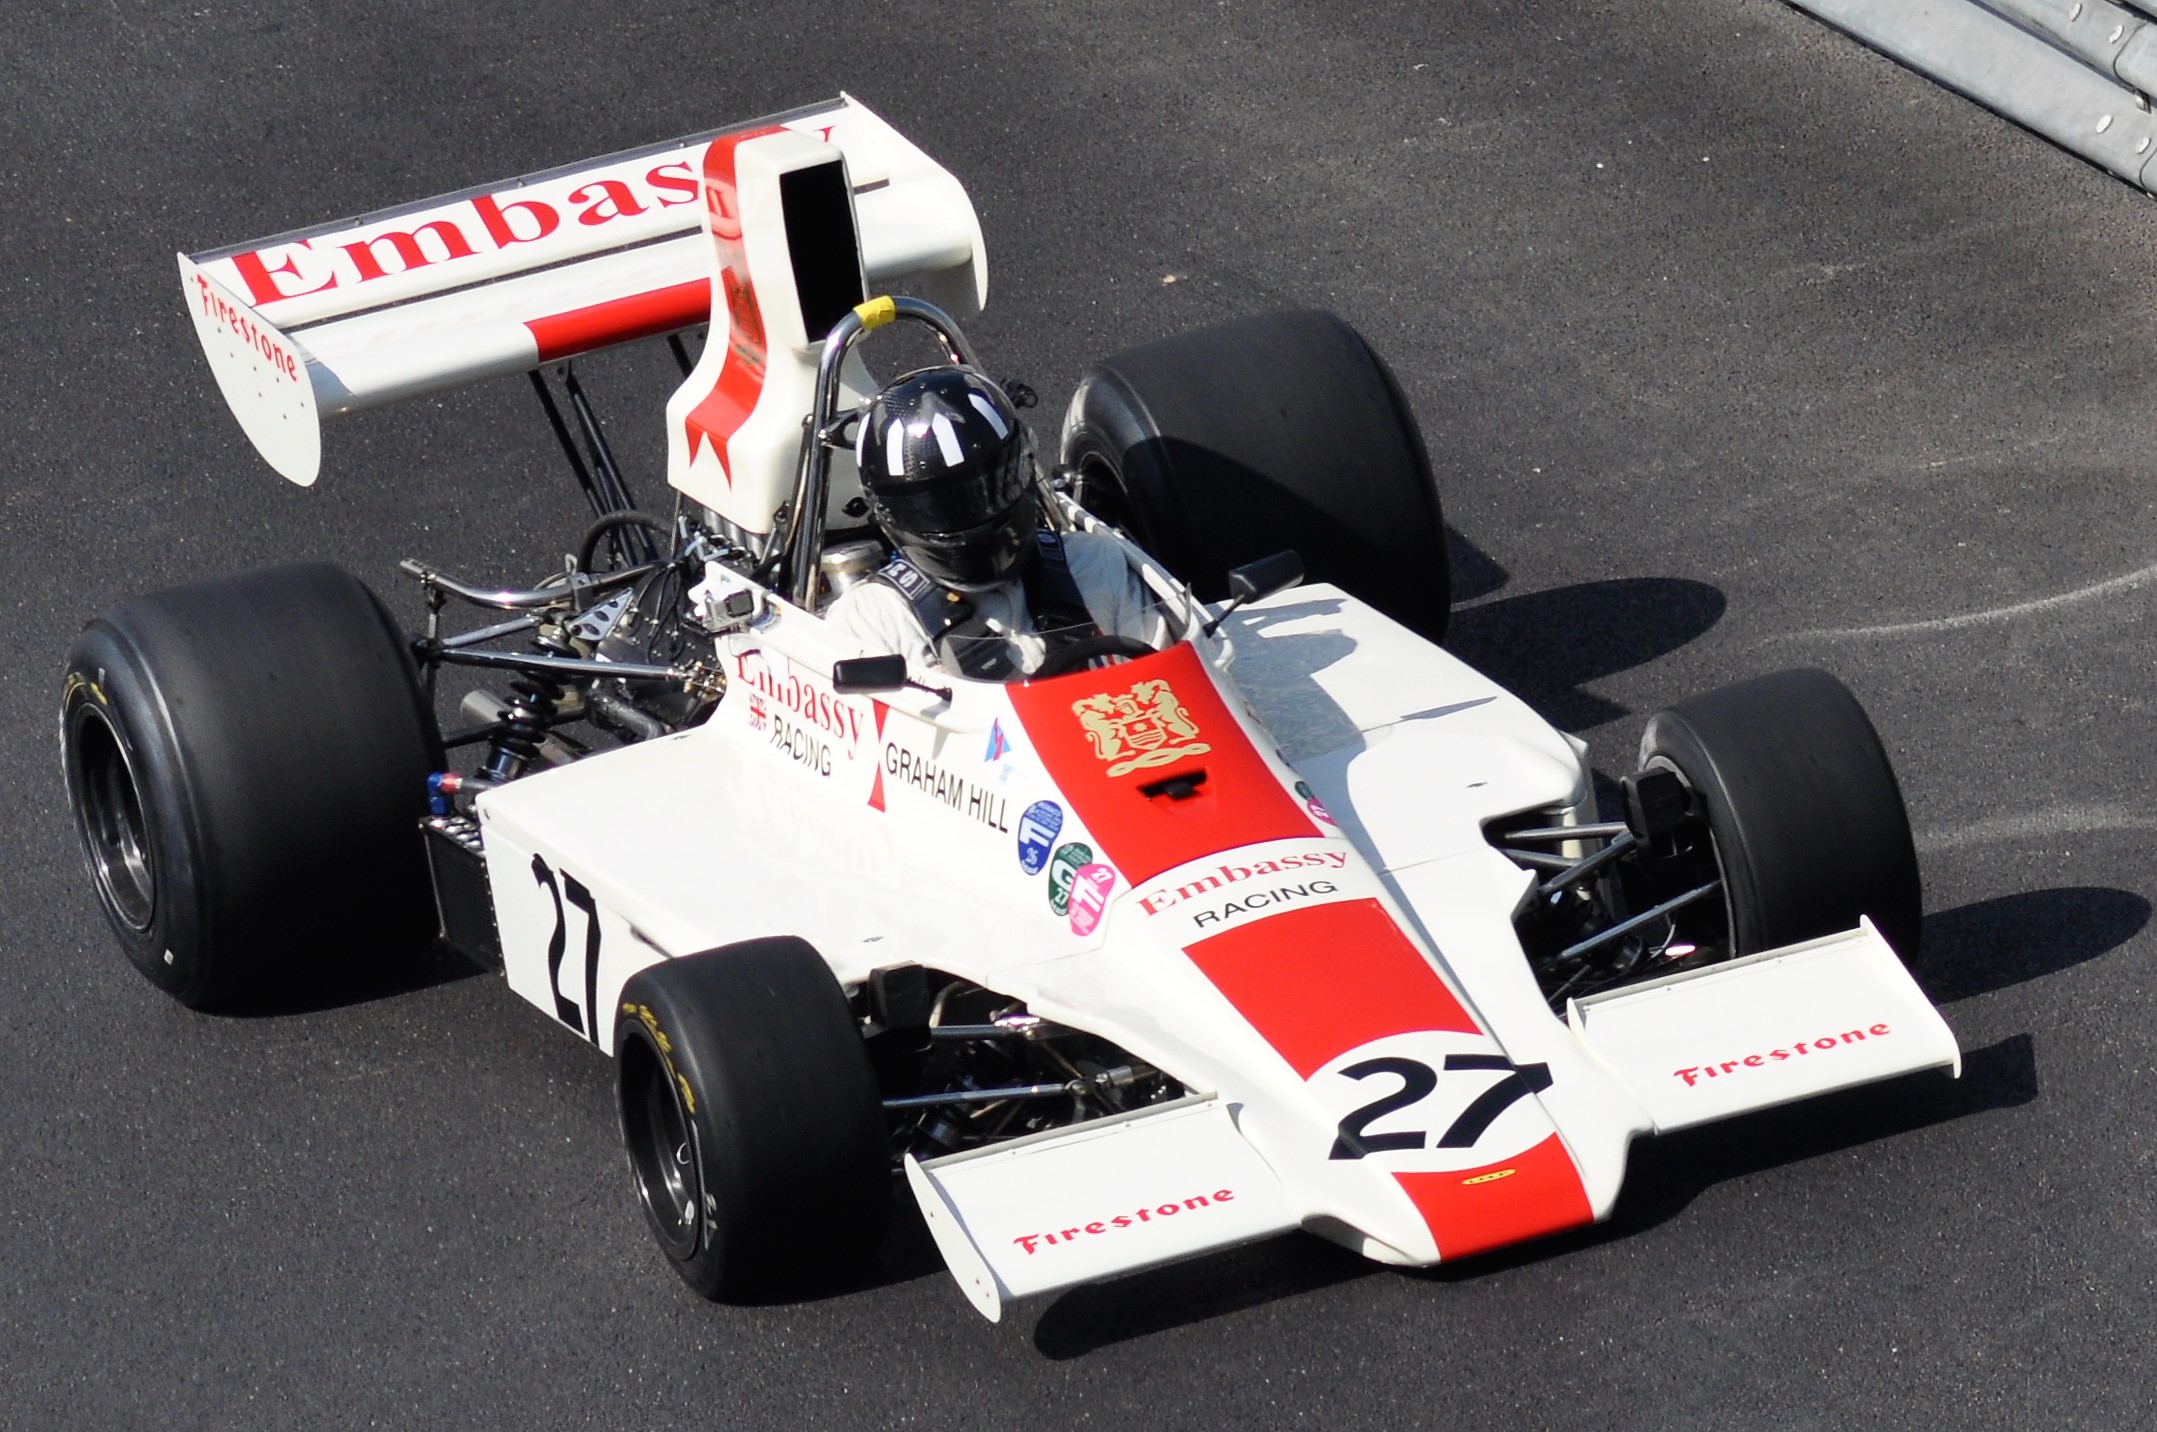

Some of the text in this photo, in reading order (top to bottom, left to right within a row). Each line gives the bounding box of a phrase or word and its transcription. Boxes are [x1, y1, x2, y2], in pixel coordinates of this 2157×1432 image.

[197, 273, 298, 383] Firestone
[769, 713, 832, 778] RACING
[885, 741, 964, 811] GRAHAM
[967, 783, 1009, 834] HILL
[1136, 852, 1348, 917] Embassy
[1192, 880, 1339, 929] RACING
[530, 852, 603, 1047] 27
[1673, 1022, 1891, 1088] Firestone
[1327, 1053, 1554, 1161] 27
[1013, 1188, 1235, 1256] Firestone
